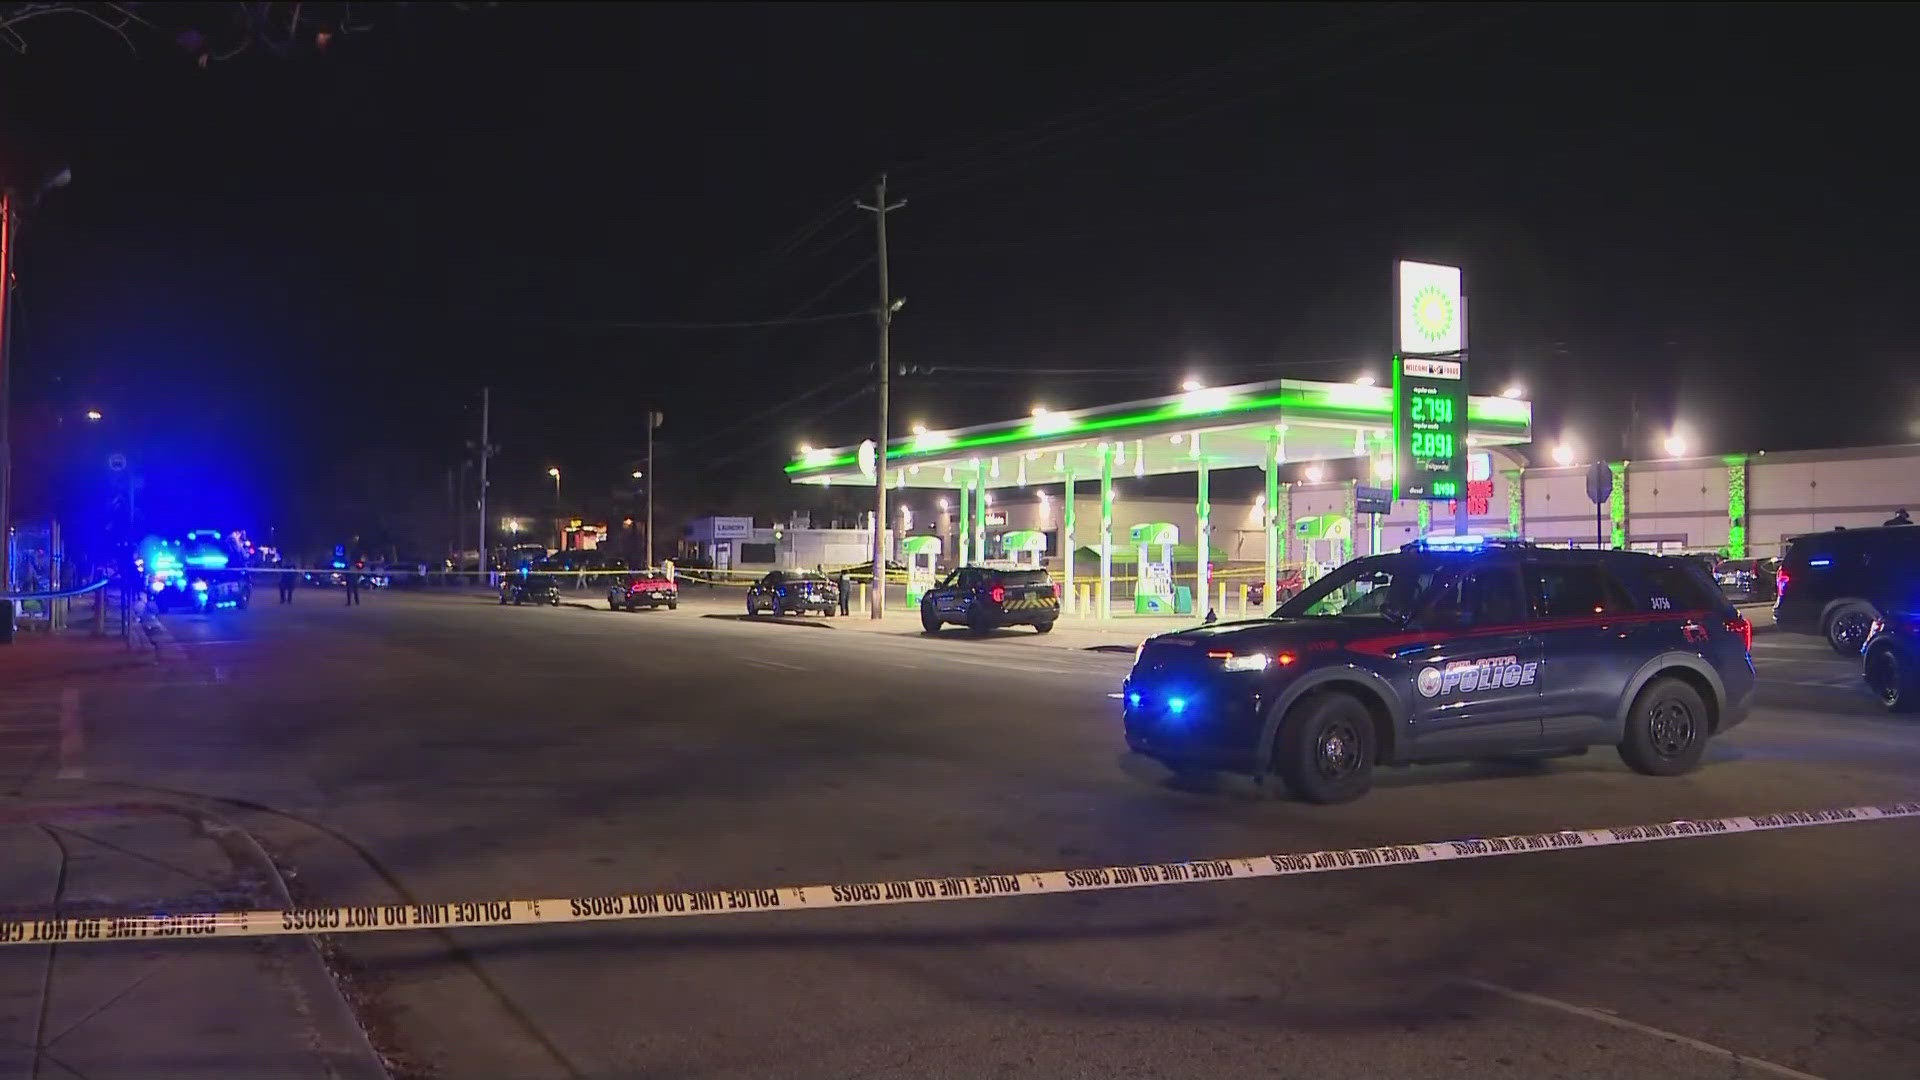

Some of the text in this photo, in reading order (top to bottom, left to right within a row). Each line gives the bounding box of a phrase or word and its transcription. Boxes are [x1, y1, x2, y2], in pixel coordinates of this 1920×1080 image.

[1440, 662, 1538, 696] POLICE
[1065, 869, 1110, 887] CROSS
[1114, 867, 1137, 883] NOT
[1192, 859, 1233, 878] POLICE
[832, 884, 880, 902] CROSS
[885, 882, 913, 899] NOT
[917, 880, 936, 897] DO
[940, 878, 970, 895] LINE
[975, 875, 1020, 893] POLICE
[571, 896, 623, 918] CROSS
[629, 894, 659, 914] NOT
[664, 892, 685, 912] DO
[690, 890, 723, 910] LINE
[729, 887, 779, 908] POLICE
[282, 909, 339, 930] CROSS
[346, 907, 378, 927] NOT
[384, 906, 407, 926] DO
[413, 904, 449, 924] LINE
[455, 901, 511, 922] POLICE
[30, 921, 68, 941] NOT
[75, 920, 100, 939] DO
[106, 918, 150, 938] LINE
